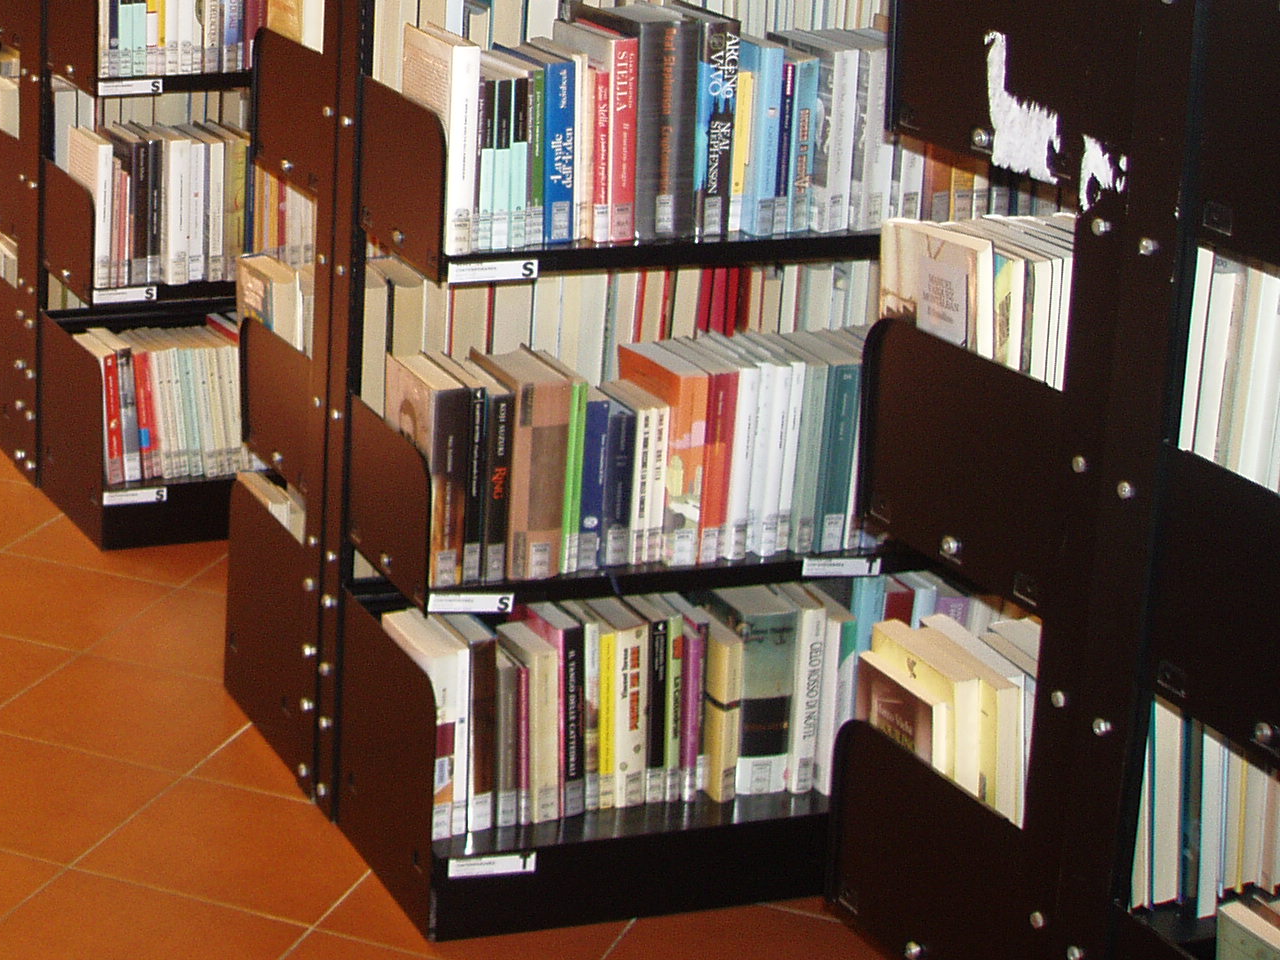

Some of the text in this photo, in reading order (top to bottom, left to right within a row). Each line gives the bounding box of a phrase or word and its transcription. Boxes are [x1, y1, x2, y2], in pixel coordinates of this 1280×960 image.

[151, 80, 160, 93] S
[616, 50, 628, 112] STELLA
[662, 56, 676, 115] Stephenson
[719, 121, 731, 153] NEAL
[522, 261, 534, 278] S
[144, 288, 154, 300] S
[497, 403, 506, 456] KOJI SUZUKI
[155, 490, 164, 501] S
[492, 466, 507, 500] RING
[497, 596, 509, 612] S
[808, 640, 823, 668] CIELO
[673, 676, 680, 688] La
[807, 668, 822, 698] ROSSO
